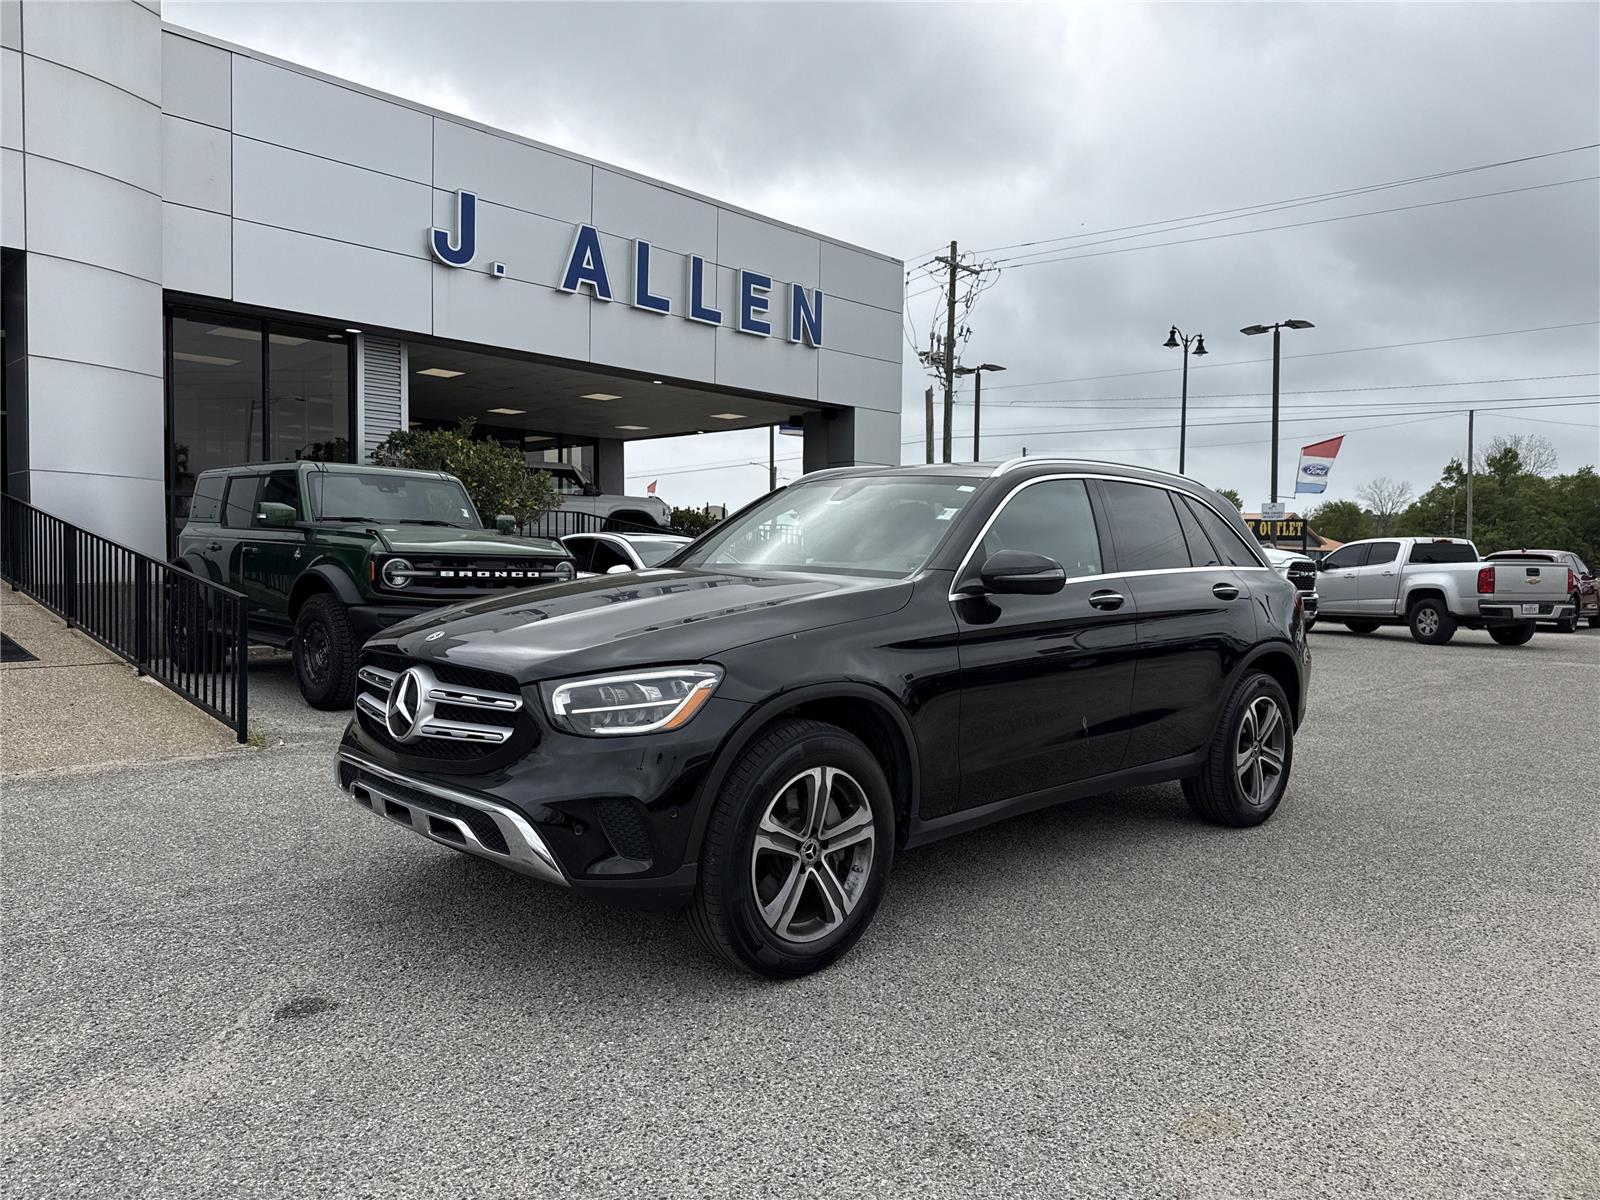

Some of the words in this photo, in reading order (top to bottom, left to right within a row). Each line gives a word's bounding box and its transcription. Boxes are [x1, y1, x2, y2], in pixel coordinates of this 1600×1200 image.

[427, 187, 507, 278] J.
[556, 222, 824, 348] ALLEN
[1306, 464, 1328, 475] Ford
